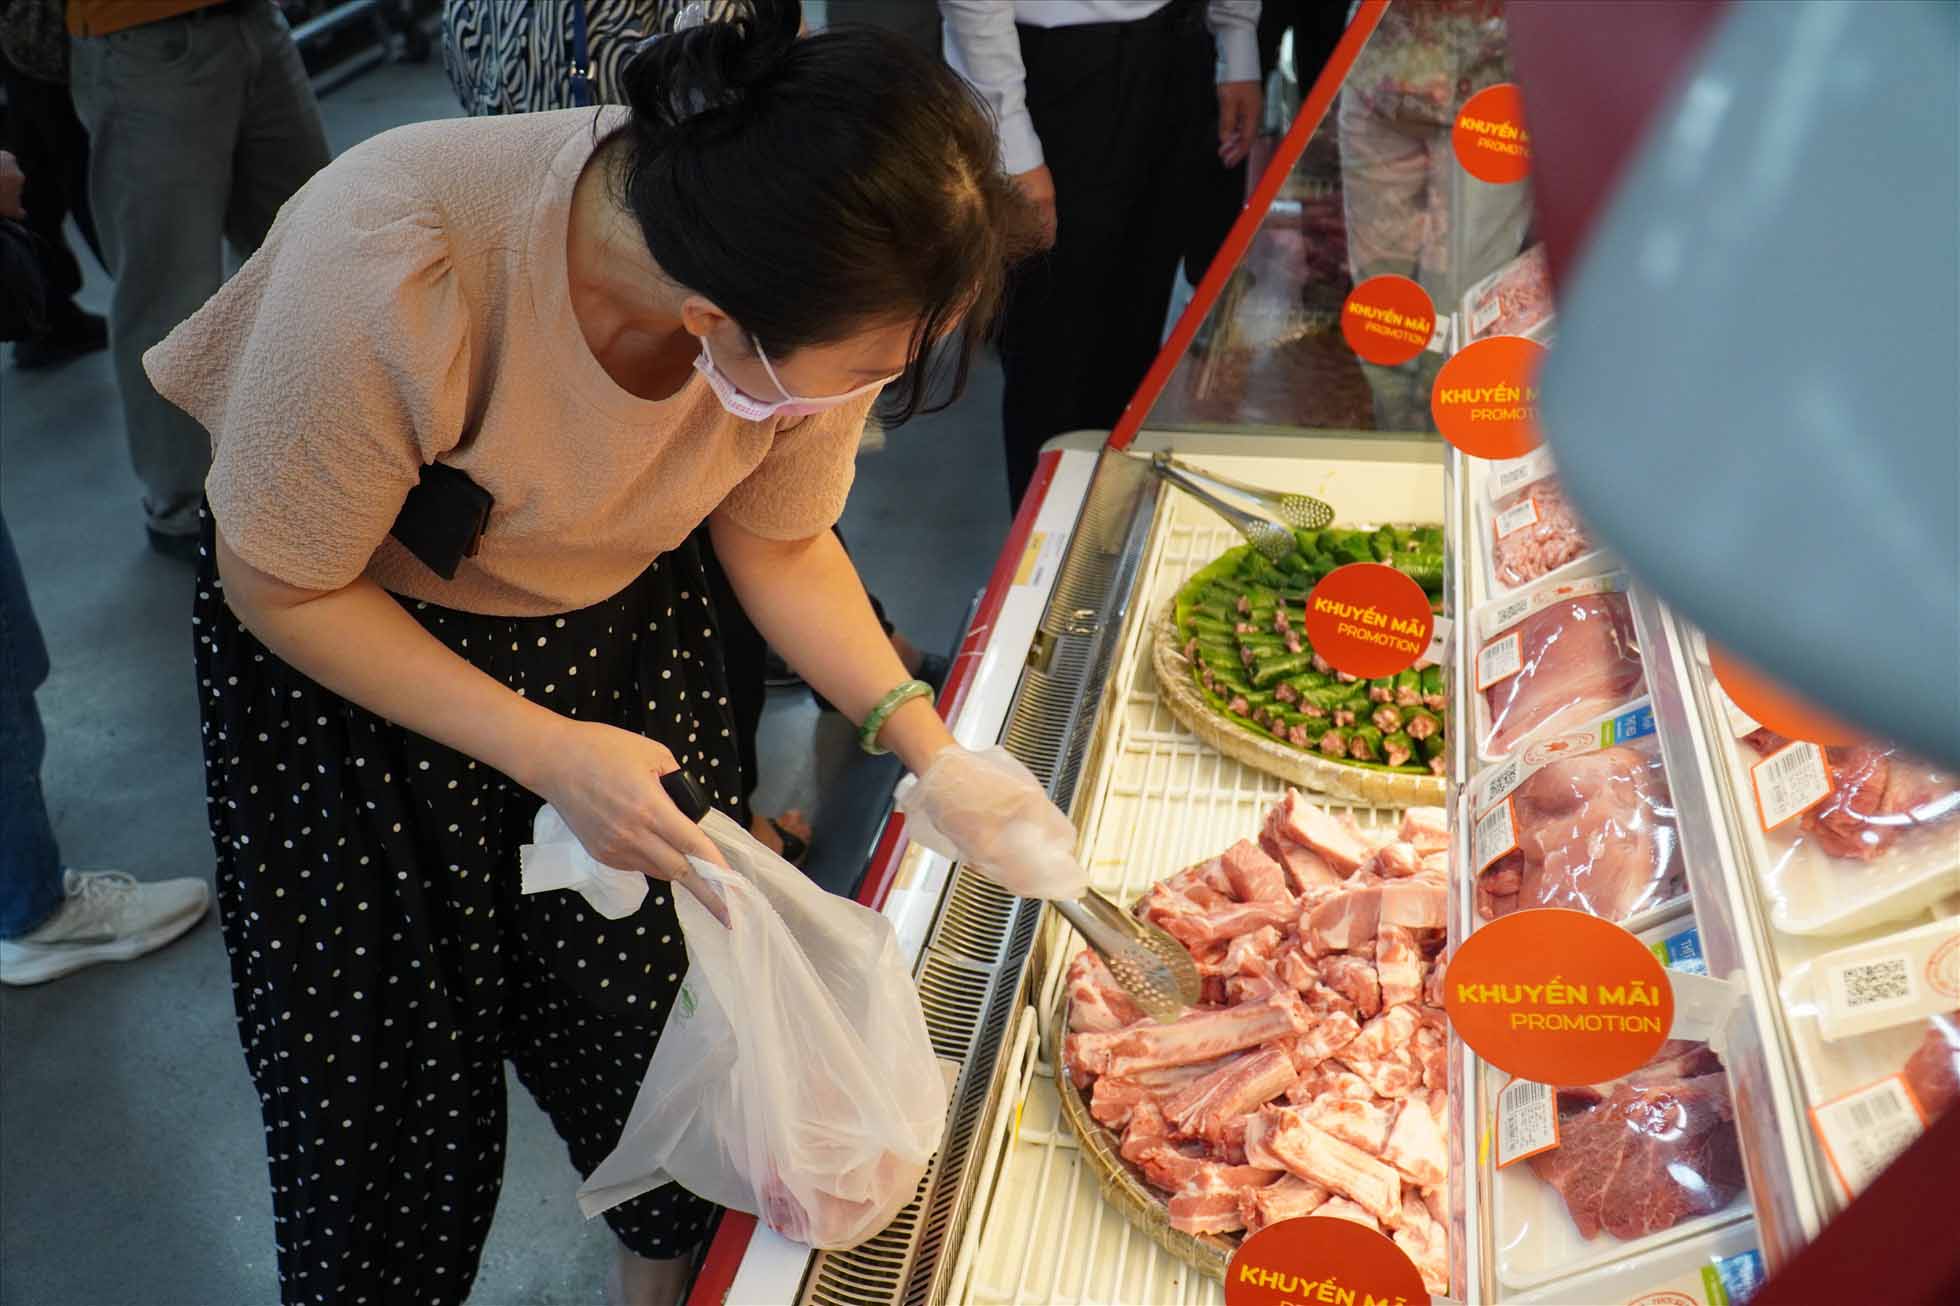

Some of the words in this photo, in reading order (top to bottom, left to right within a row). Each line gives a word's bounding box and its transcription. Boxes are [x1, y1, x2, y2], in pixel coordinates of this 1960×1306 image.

[1364, 321, 1426, 346] PROMOTION
[1337, 622, 1420, 654] PROMOTION
[1391, 617, 1426, 638] MÃI
[1457, 976, 1589, 1005] KHUYẾN
[1599, 980, 1660, 1007] MÃI
[1511, 1012, 1661, 1033] PROMOTION
